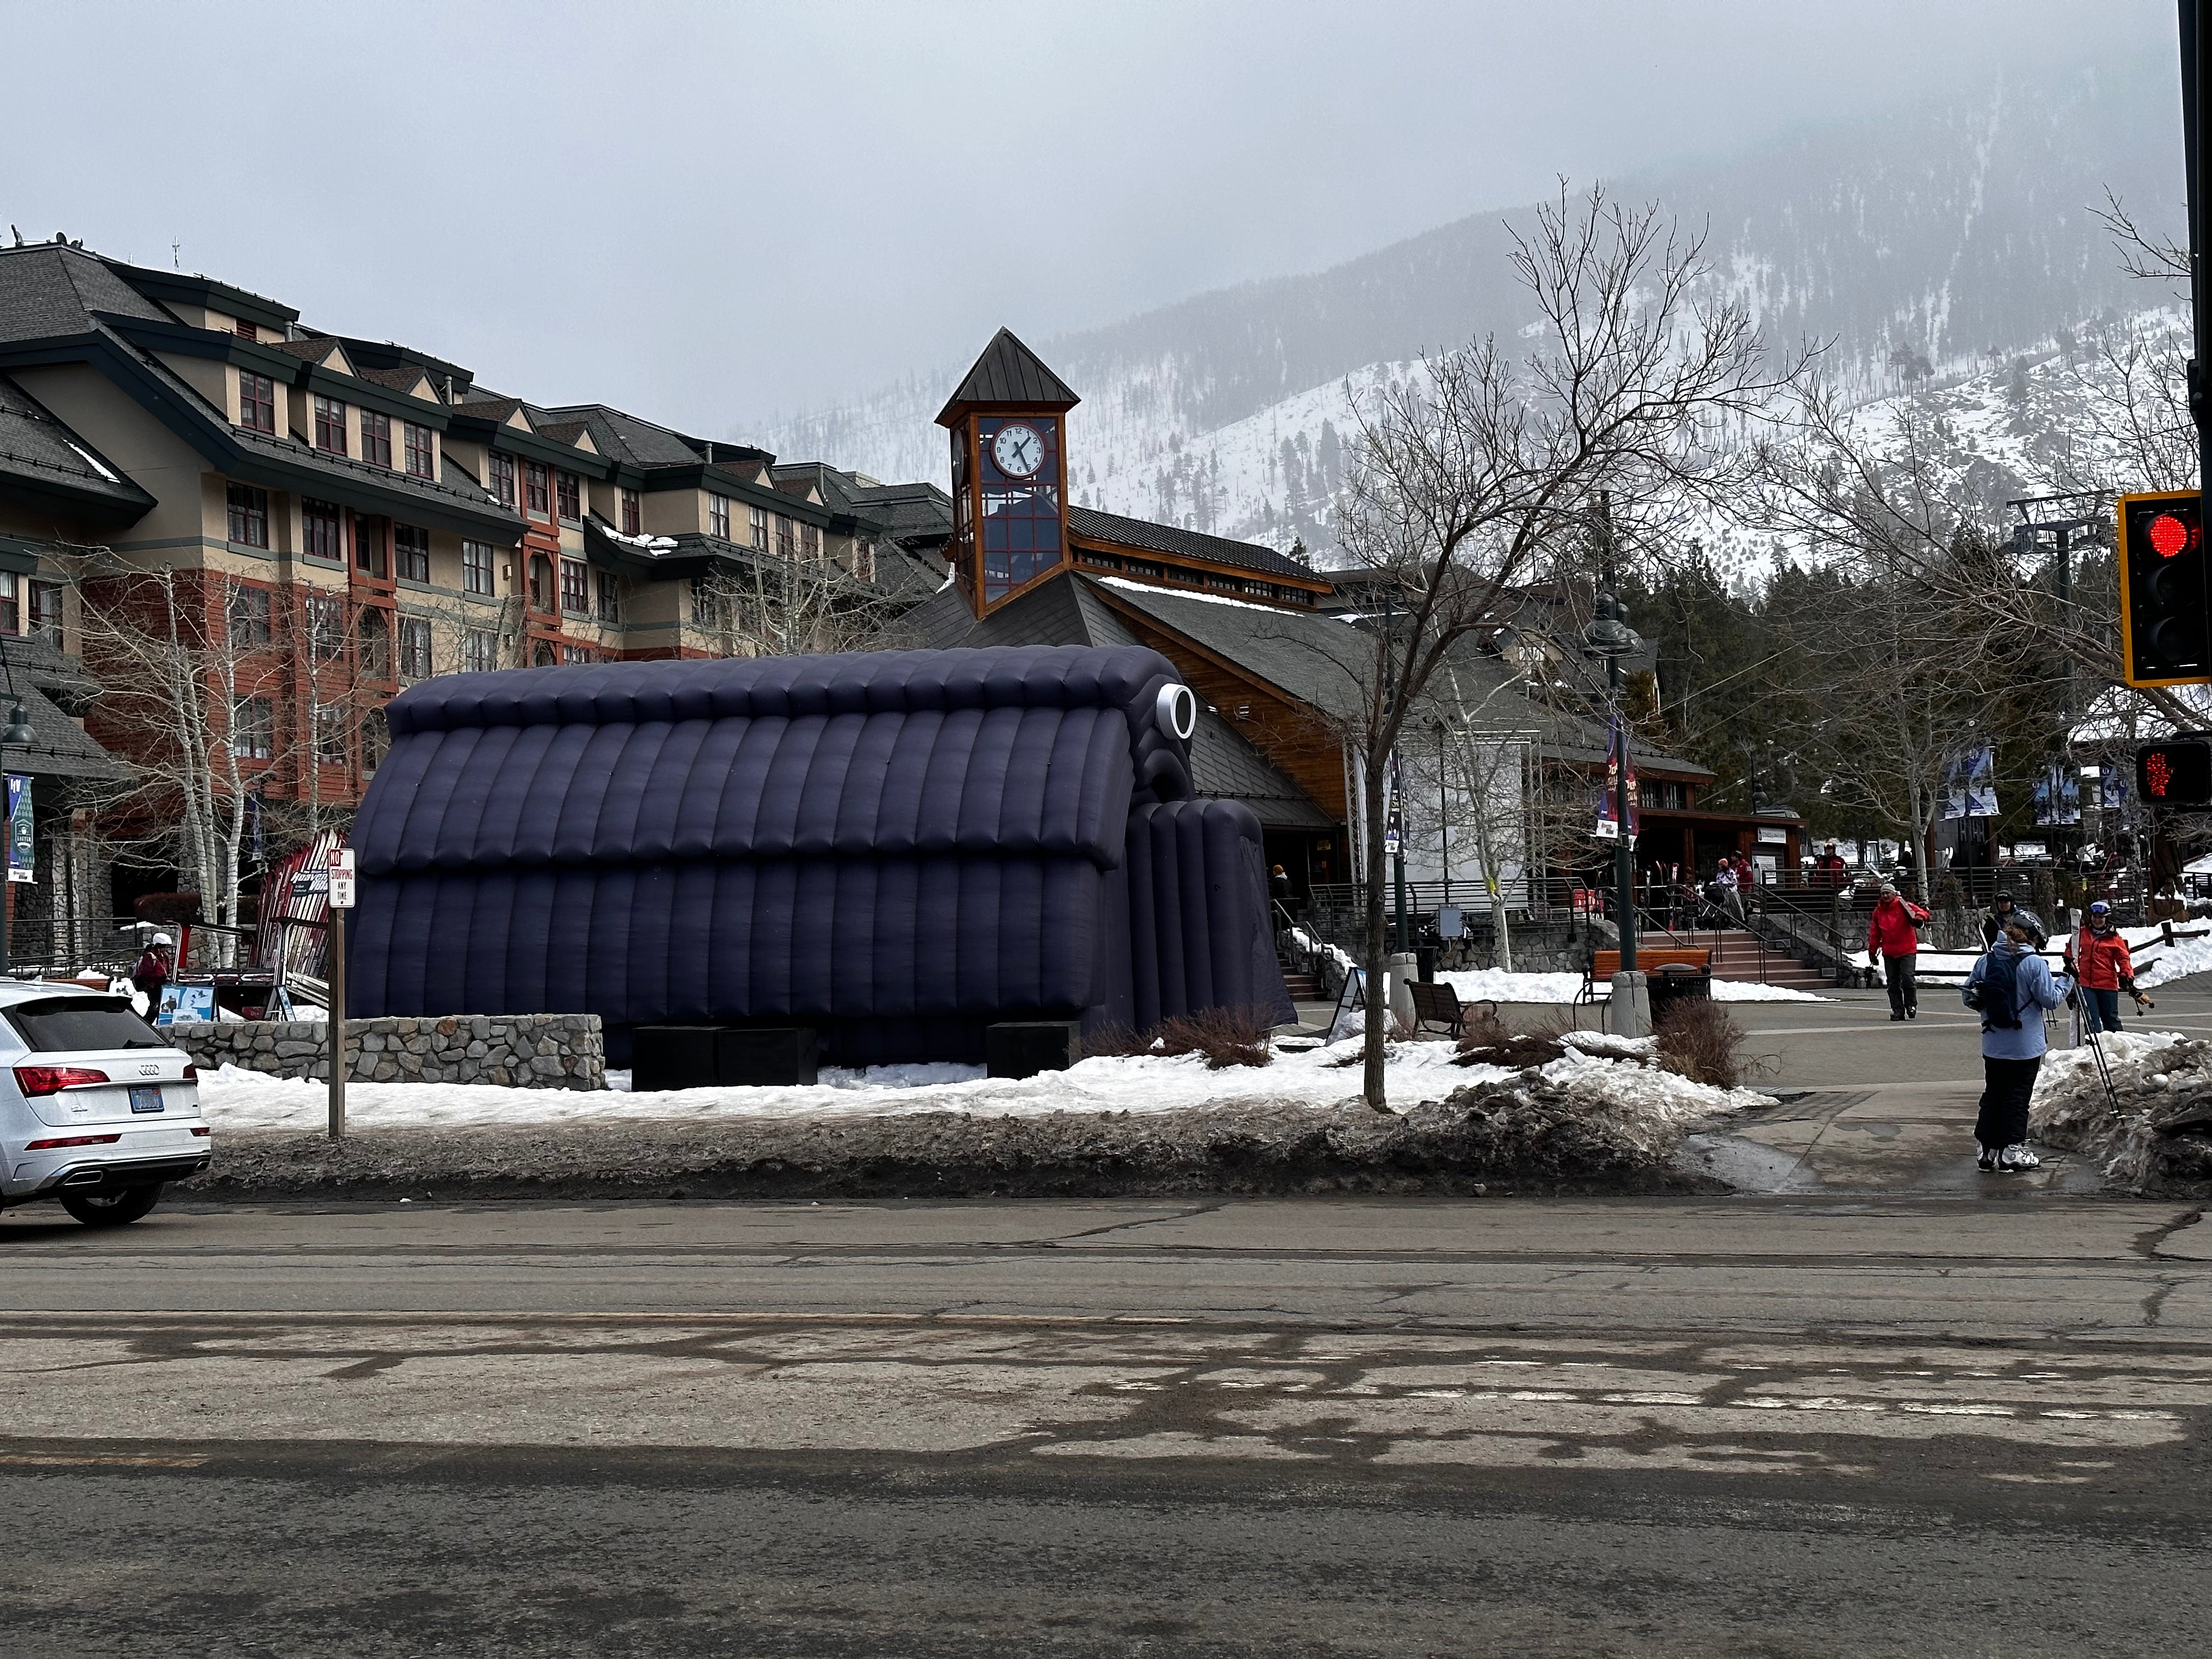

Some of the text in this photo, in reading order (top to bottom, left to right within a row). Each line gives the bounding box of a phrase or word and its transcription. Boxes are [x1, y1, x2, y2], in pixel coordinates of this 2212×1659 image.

[330, 851, 340, 865] NO
[290, 871, 328, 884] Heaven
[331, 868, 353, 879] STOPPING
[337, 882, 347, 890] ANY
[337, 891, 347, 900] TIME
